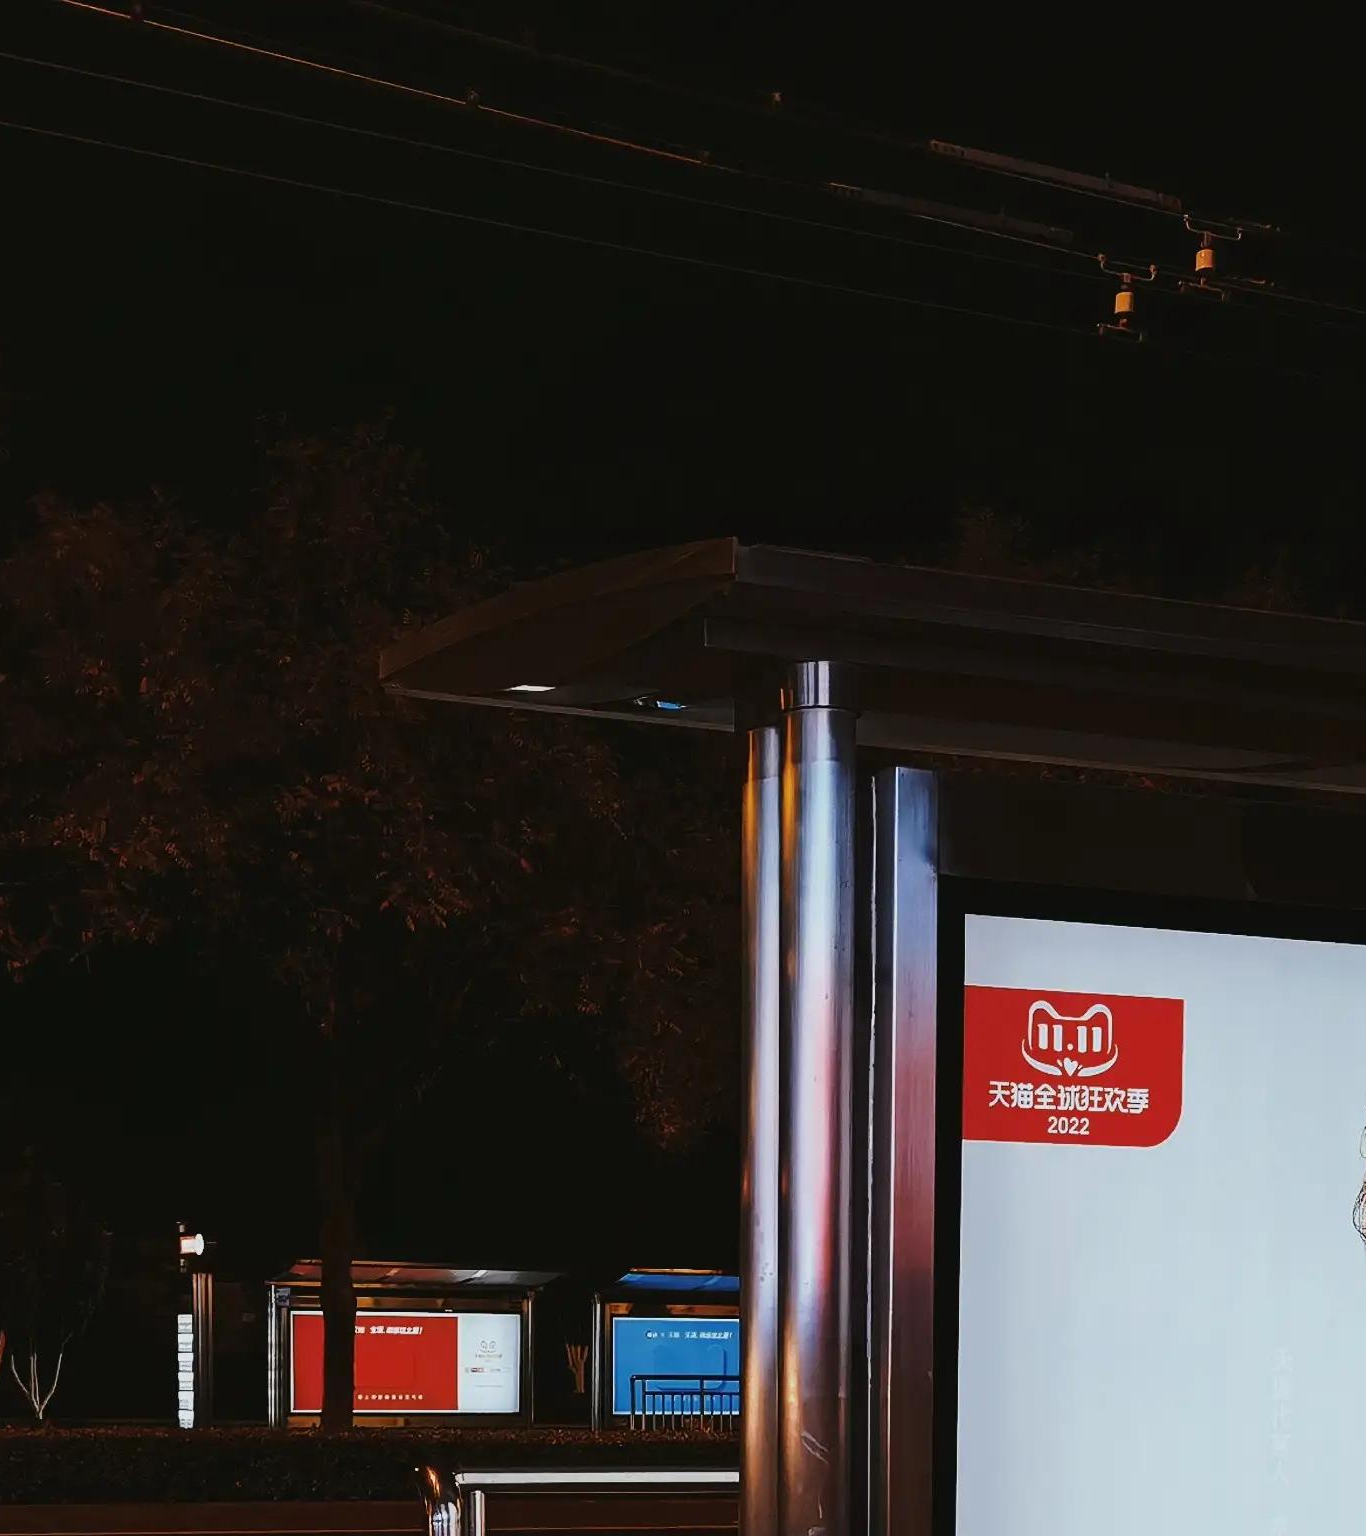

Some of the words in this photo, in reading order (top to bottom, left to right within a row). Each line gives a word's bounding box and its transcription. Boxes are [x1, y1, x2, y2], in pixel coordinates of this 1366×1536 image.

[1036, 1023, 1103, 1053] 11.11
[988, 1080, 1150, 1114] 天猫全球狂欢季
[1047, 1115, 1091, 1136] 2022
